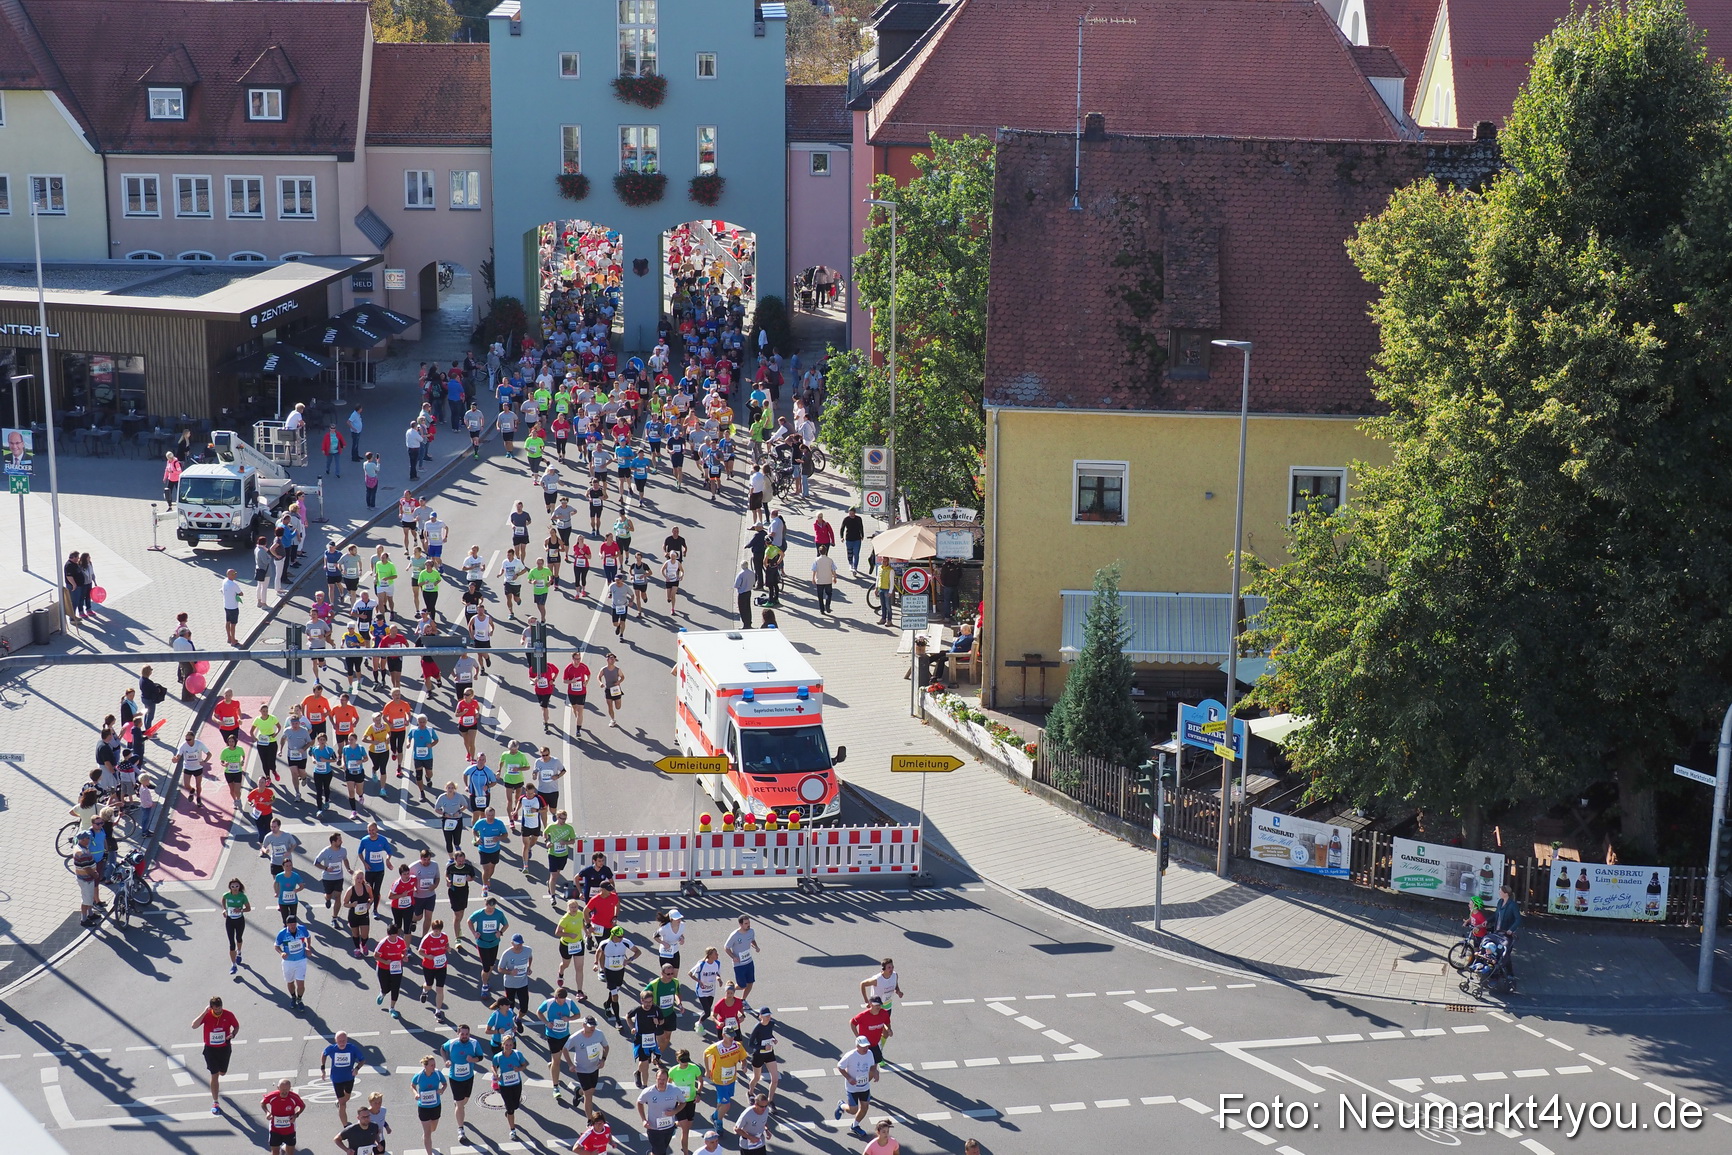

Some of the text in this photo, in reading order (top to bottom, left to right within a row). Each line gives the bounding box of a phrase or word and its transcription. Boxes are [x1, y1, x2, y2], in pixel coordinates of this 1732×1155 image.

[261, 299, 299, 322] ZENTRAL
[263, 354, 280, 371] now
[669, 761, 721, 771] Umleitung
[898, 759, 950, 770] Umleitung
[1676, 767, 1689, 776] Untere
[1258, 825, 1295, 839] GANSBRÄU
[1401, 854, 1441, 866] GANSBRÄU
[1595, 868, 1644, 877] GANSBRÄU
[1618, 893, 1632, 901] Sie
